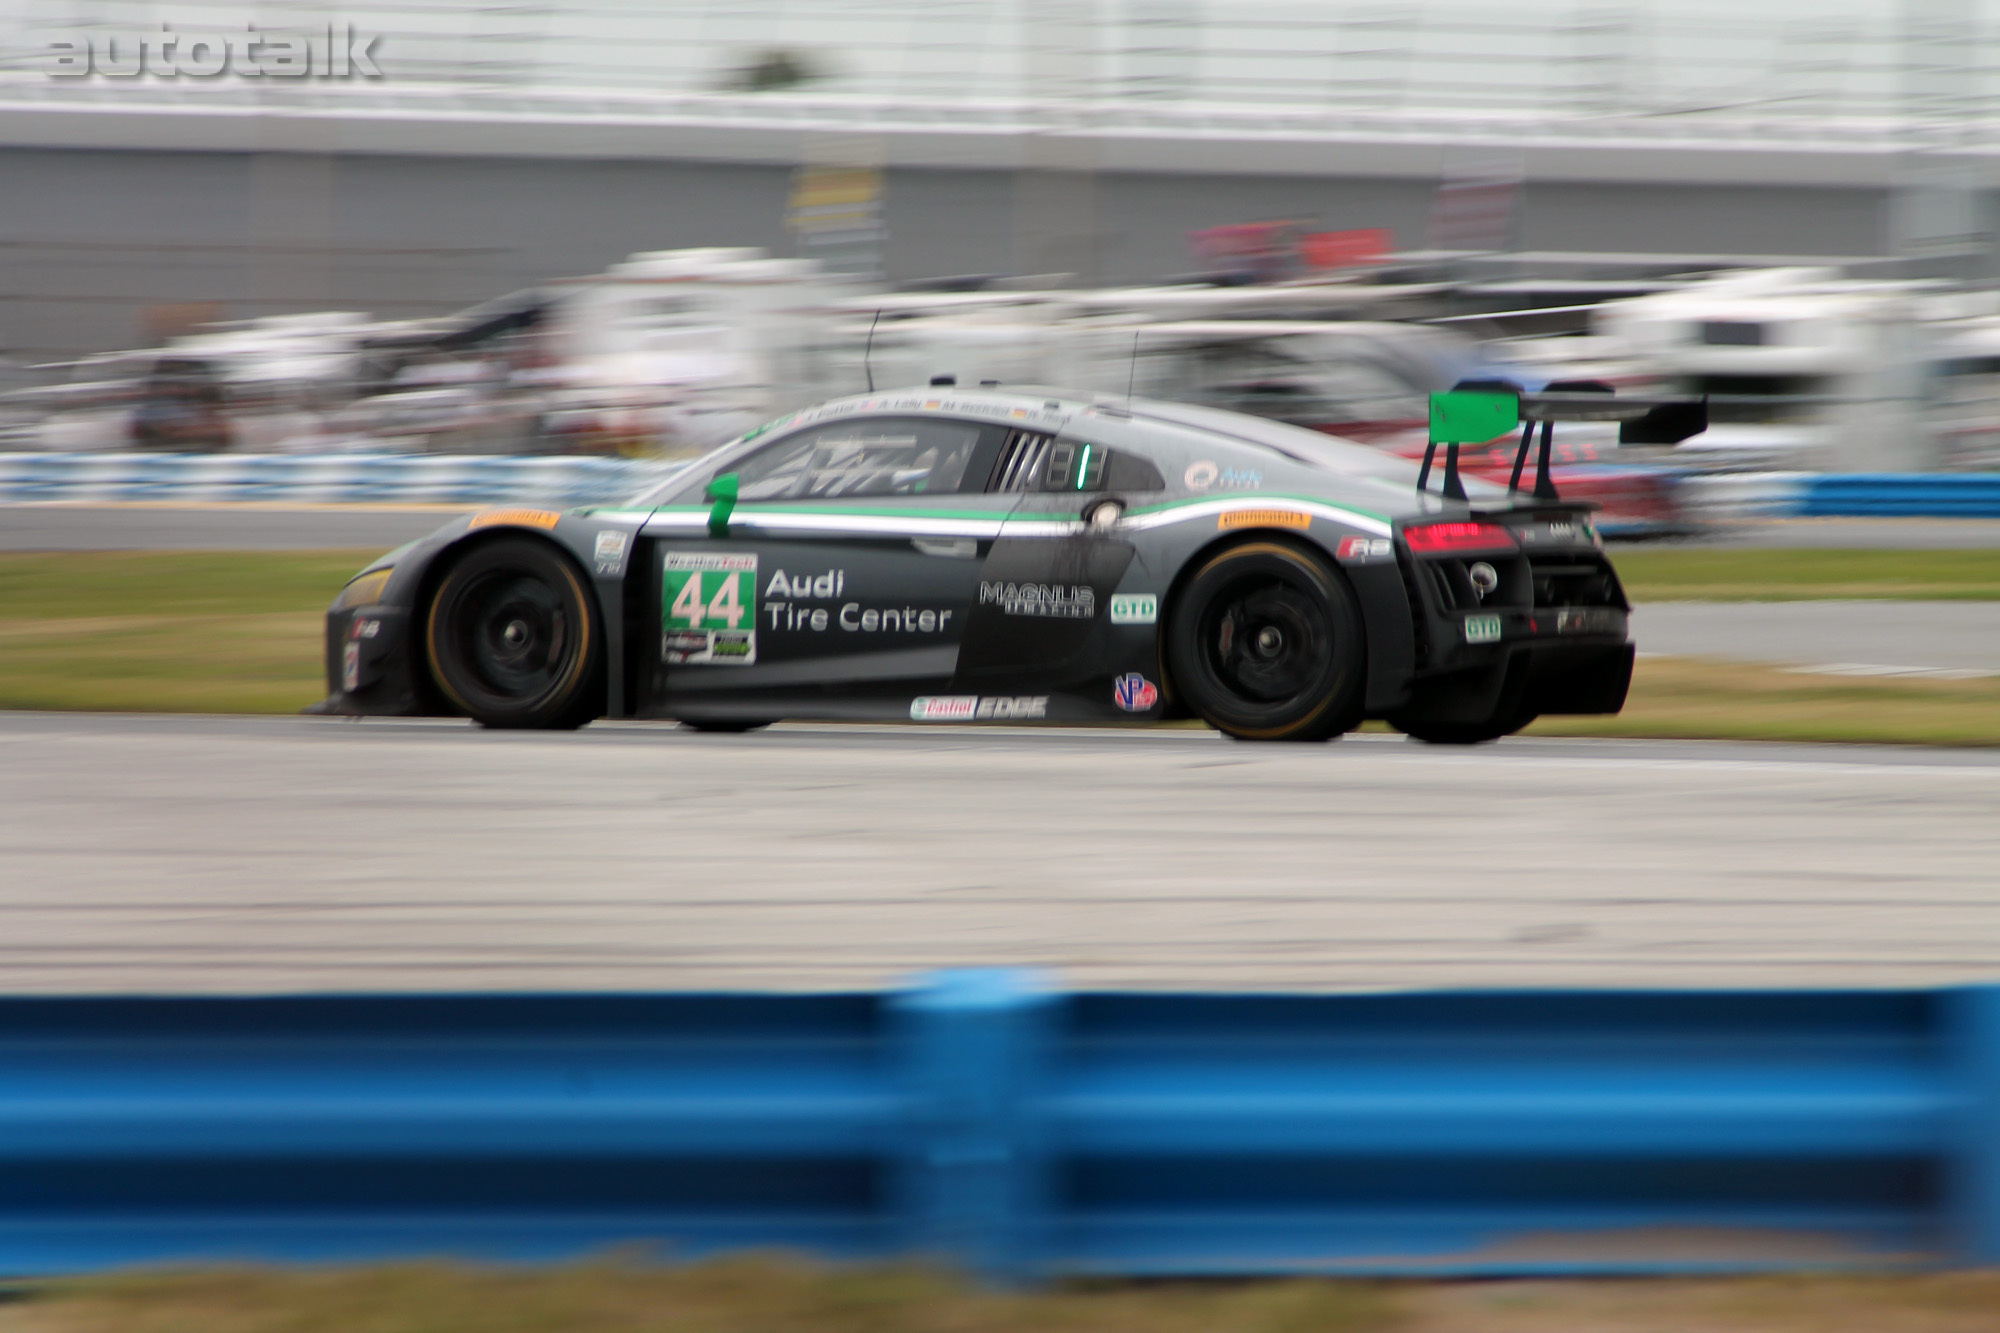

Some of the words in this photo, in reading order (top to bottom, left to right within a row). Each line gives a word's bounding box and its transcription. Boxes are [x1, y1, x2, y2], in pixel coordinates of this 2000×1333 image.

[765, 568, 844, 598] Audi
[979, 581, 1095, 608] MAGNUS
[670, 570, 745, 631] 44
[1113, 601, 1154, 618] GTD
[764, 602, 828, 632] Tire
[840, 602, 952, 633] Center
[1467, 620, 1499, 639] GTD
[1115, 671, 1145, 711] VP
[927, 697, 972, 717] Castrol
[976, 696, 1049, 718] EDGE
